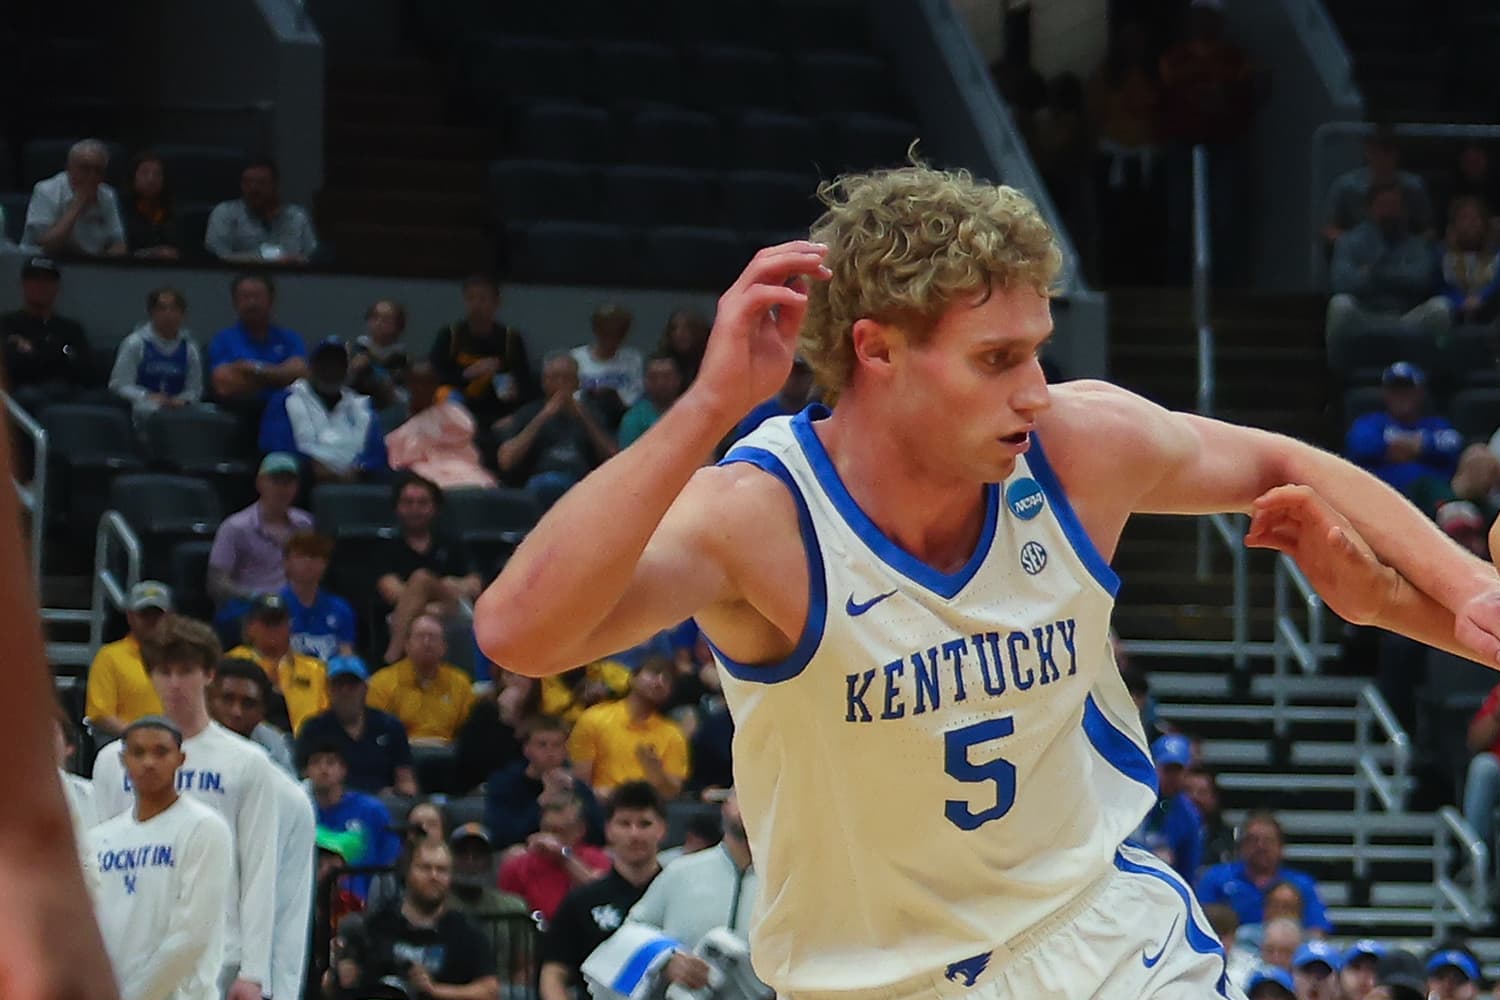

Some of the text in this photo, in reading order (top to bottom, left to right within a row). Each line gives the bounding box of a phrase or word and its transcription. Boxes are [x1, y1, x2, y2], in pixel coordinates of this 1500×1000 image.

[1014, 492, 1043, 513] NCAA
[1021, 541, 1047, 575] SEC
[845, 618, 1078, 723] KENTUCKY
[944, 715, 1018, 832] 5
